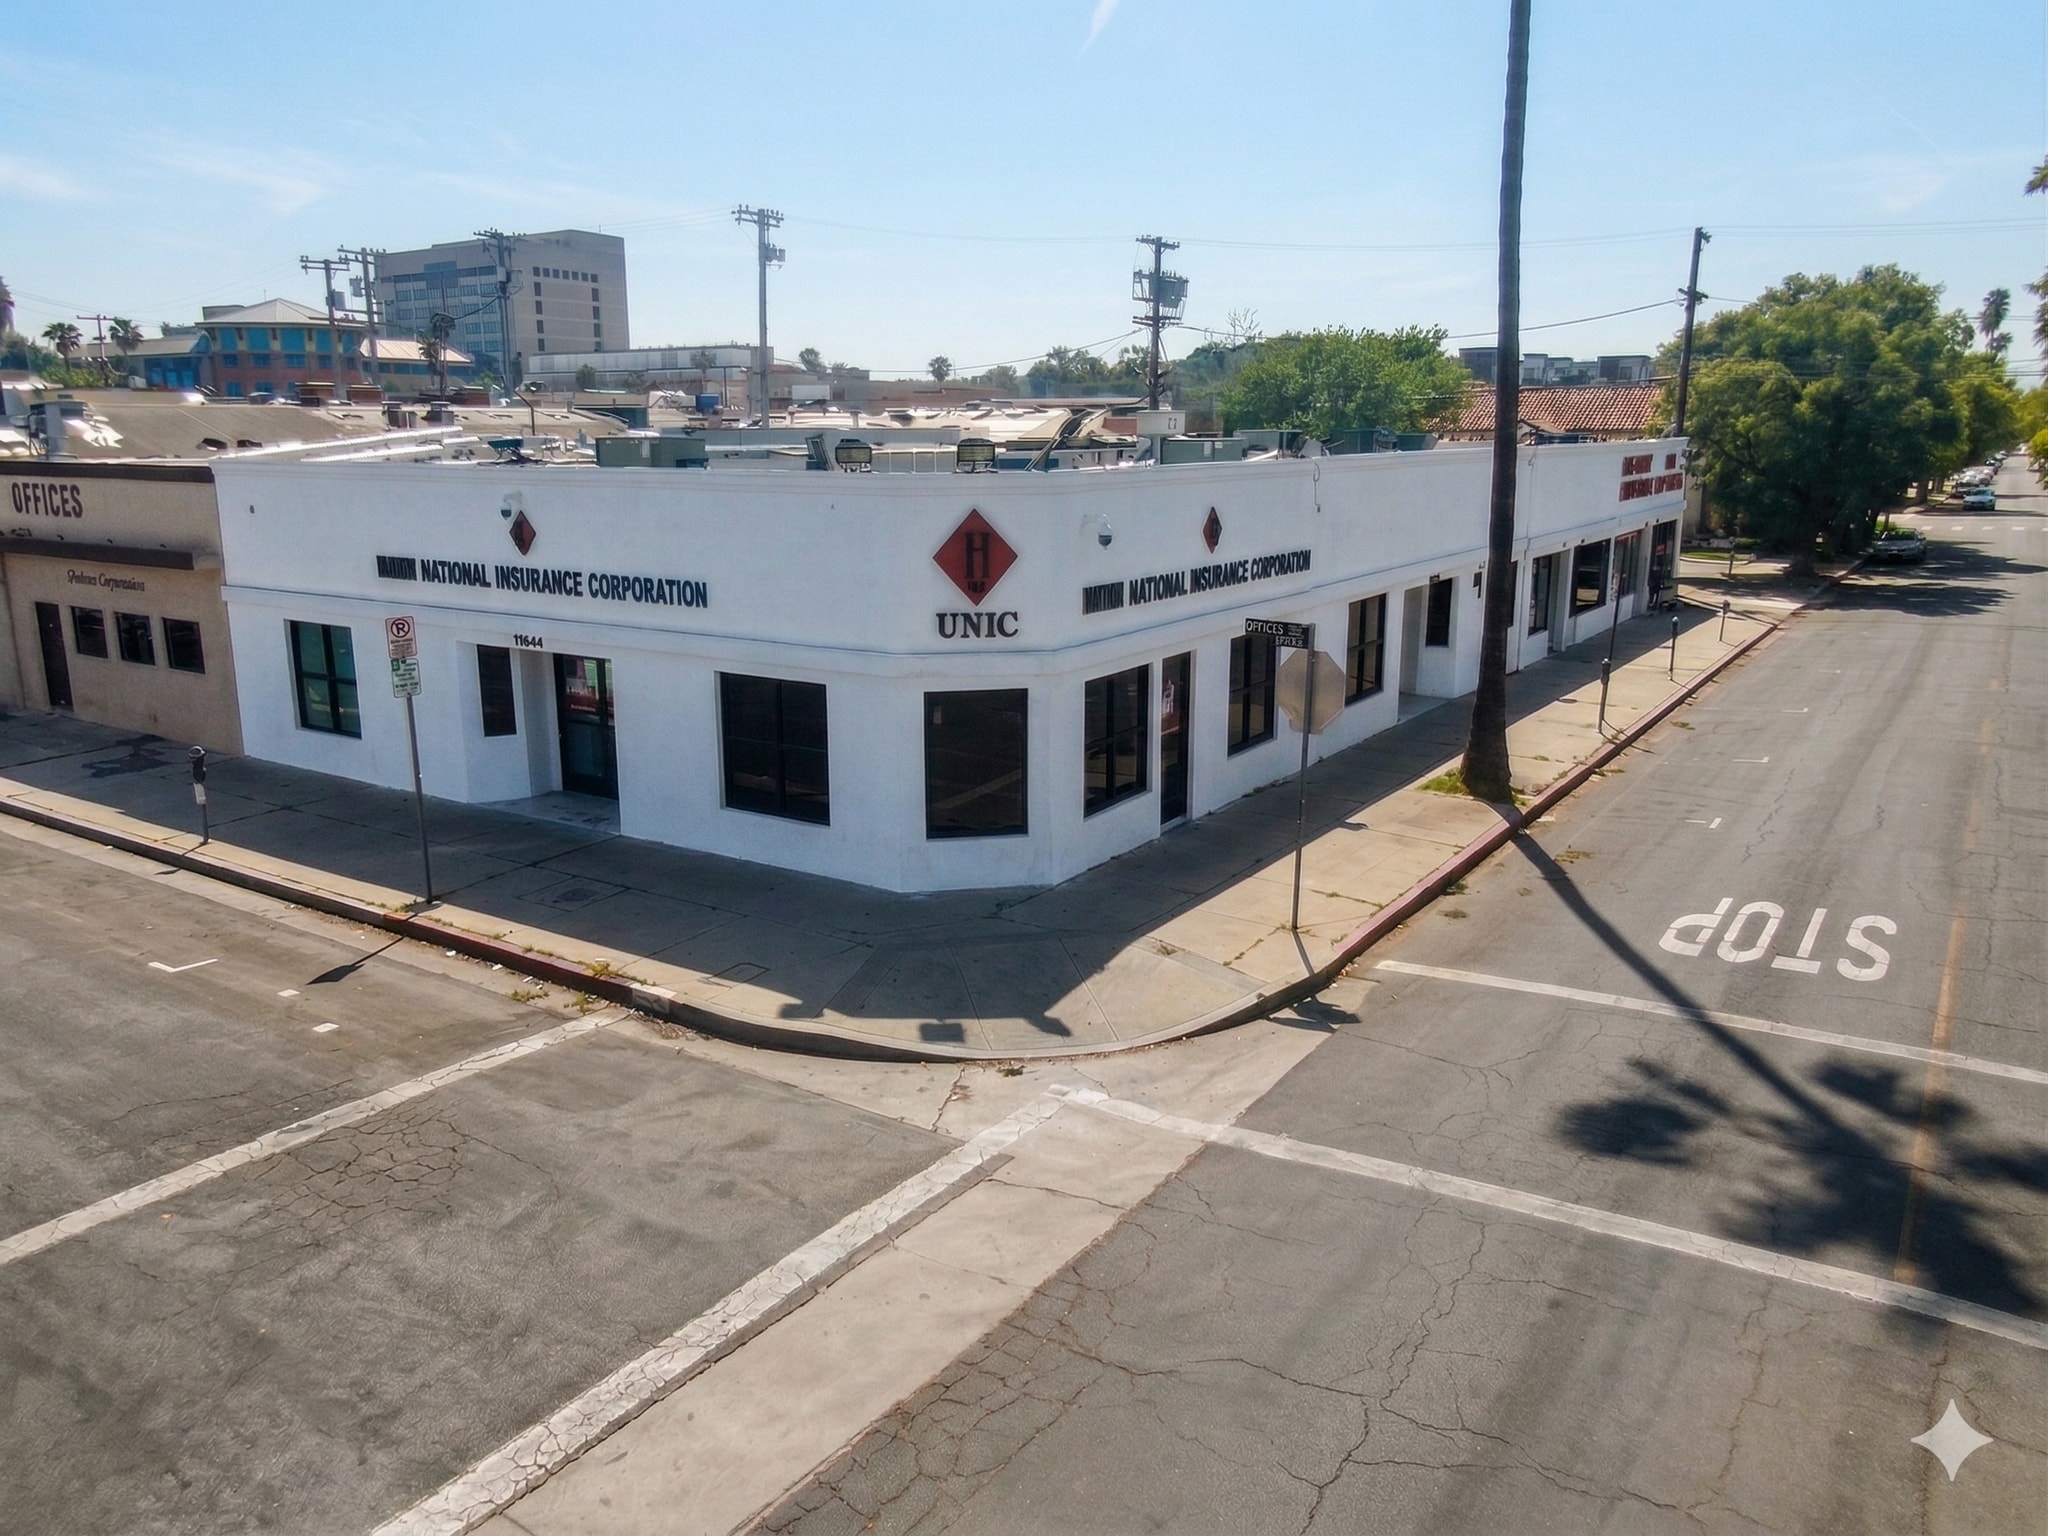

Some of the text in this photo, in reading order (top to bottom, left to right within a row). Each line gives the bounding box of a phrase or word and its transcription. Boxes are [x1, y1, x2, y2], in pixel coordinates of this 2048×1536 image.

[11, 482, 83, 518] OFFICES
[421, 558, 491, 588] NATIONAL
[495, 565, 583, 597] INSURANCE
[588, 573, 708, 608] CORPORATION
[1129, 572, 1188, 606] NATIONAL
[1190, 559, 1249, 595] INSURANCE
[1251, 549, 1311, 581] CORPORATION
[513, 633, 544, 649] 11644
[936, 611, 1019, 640] UNIC
[1658, 897, 1898, 982] STOP
